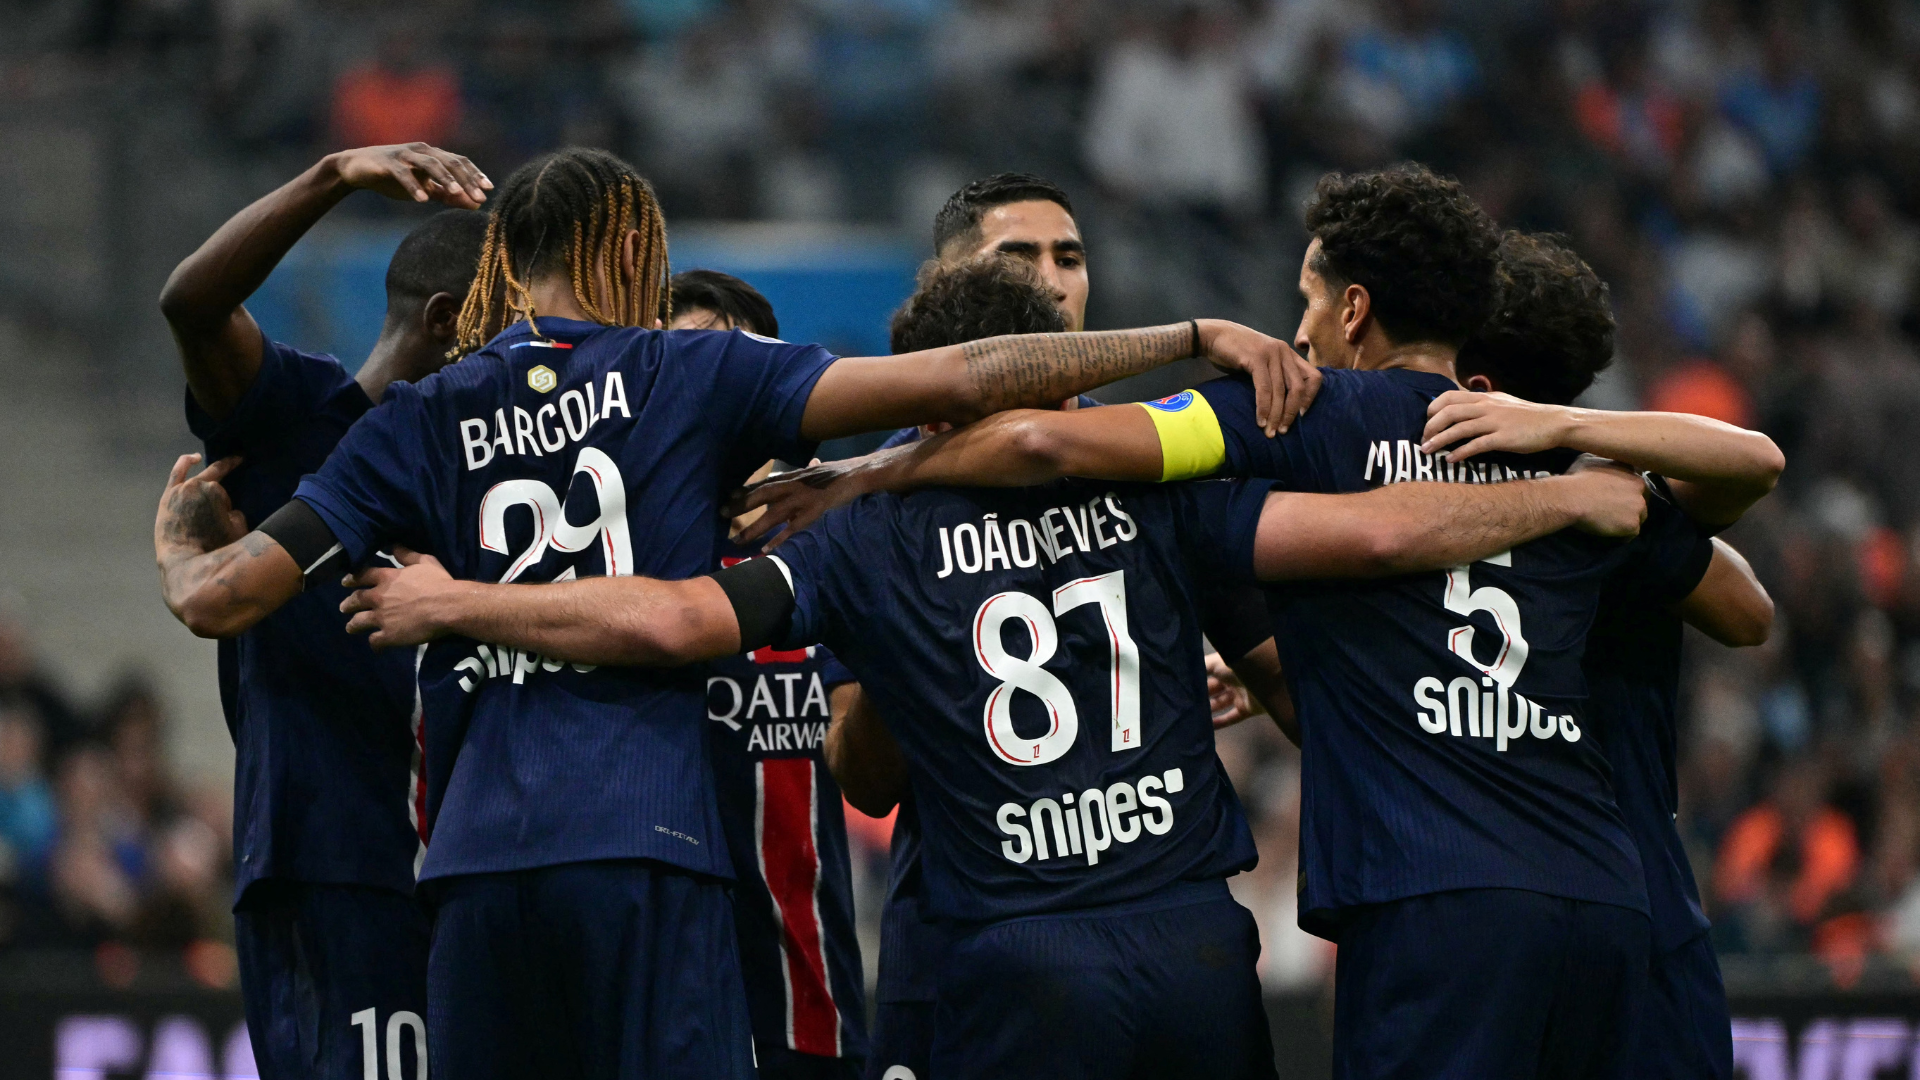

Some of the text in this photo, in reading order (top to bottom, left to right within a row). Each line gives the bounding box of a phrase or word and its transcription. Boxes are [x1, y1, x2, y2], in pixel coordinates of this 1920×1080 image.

[460, 371, 631, 471] BARCOLA
[479, 446, 634, 585] 29
[937, 491, 1138, 579] JOÃO NEVES
[1444, 550, 1529, 689] 5
[707, 671, 830, 732] QATA
[972, 569, 1142, 766] 87
[747, 721, 830, 752] AIRWA
[996, 774, 1176, 867] snipes
[350, 1006, 428, 1080] 10
